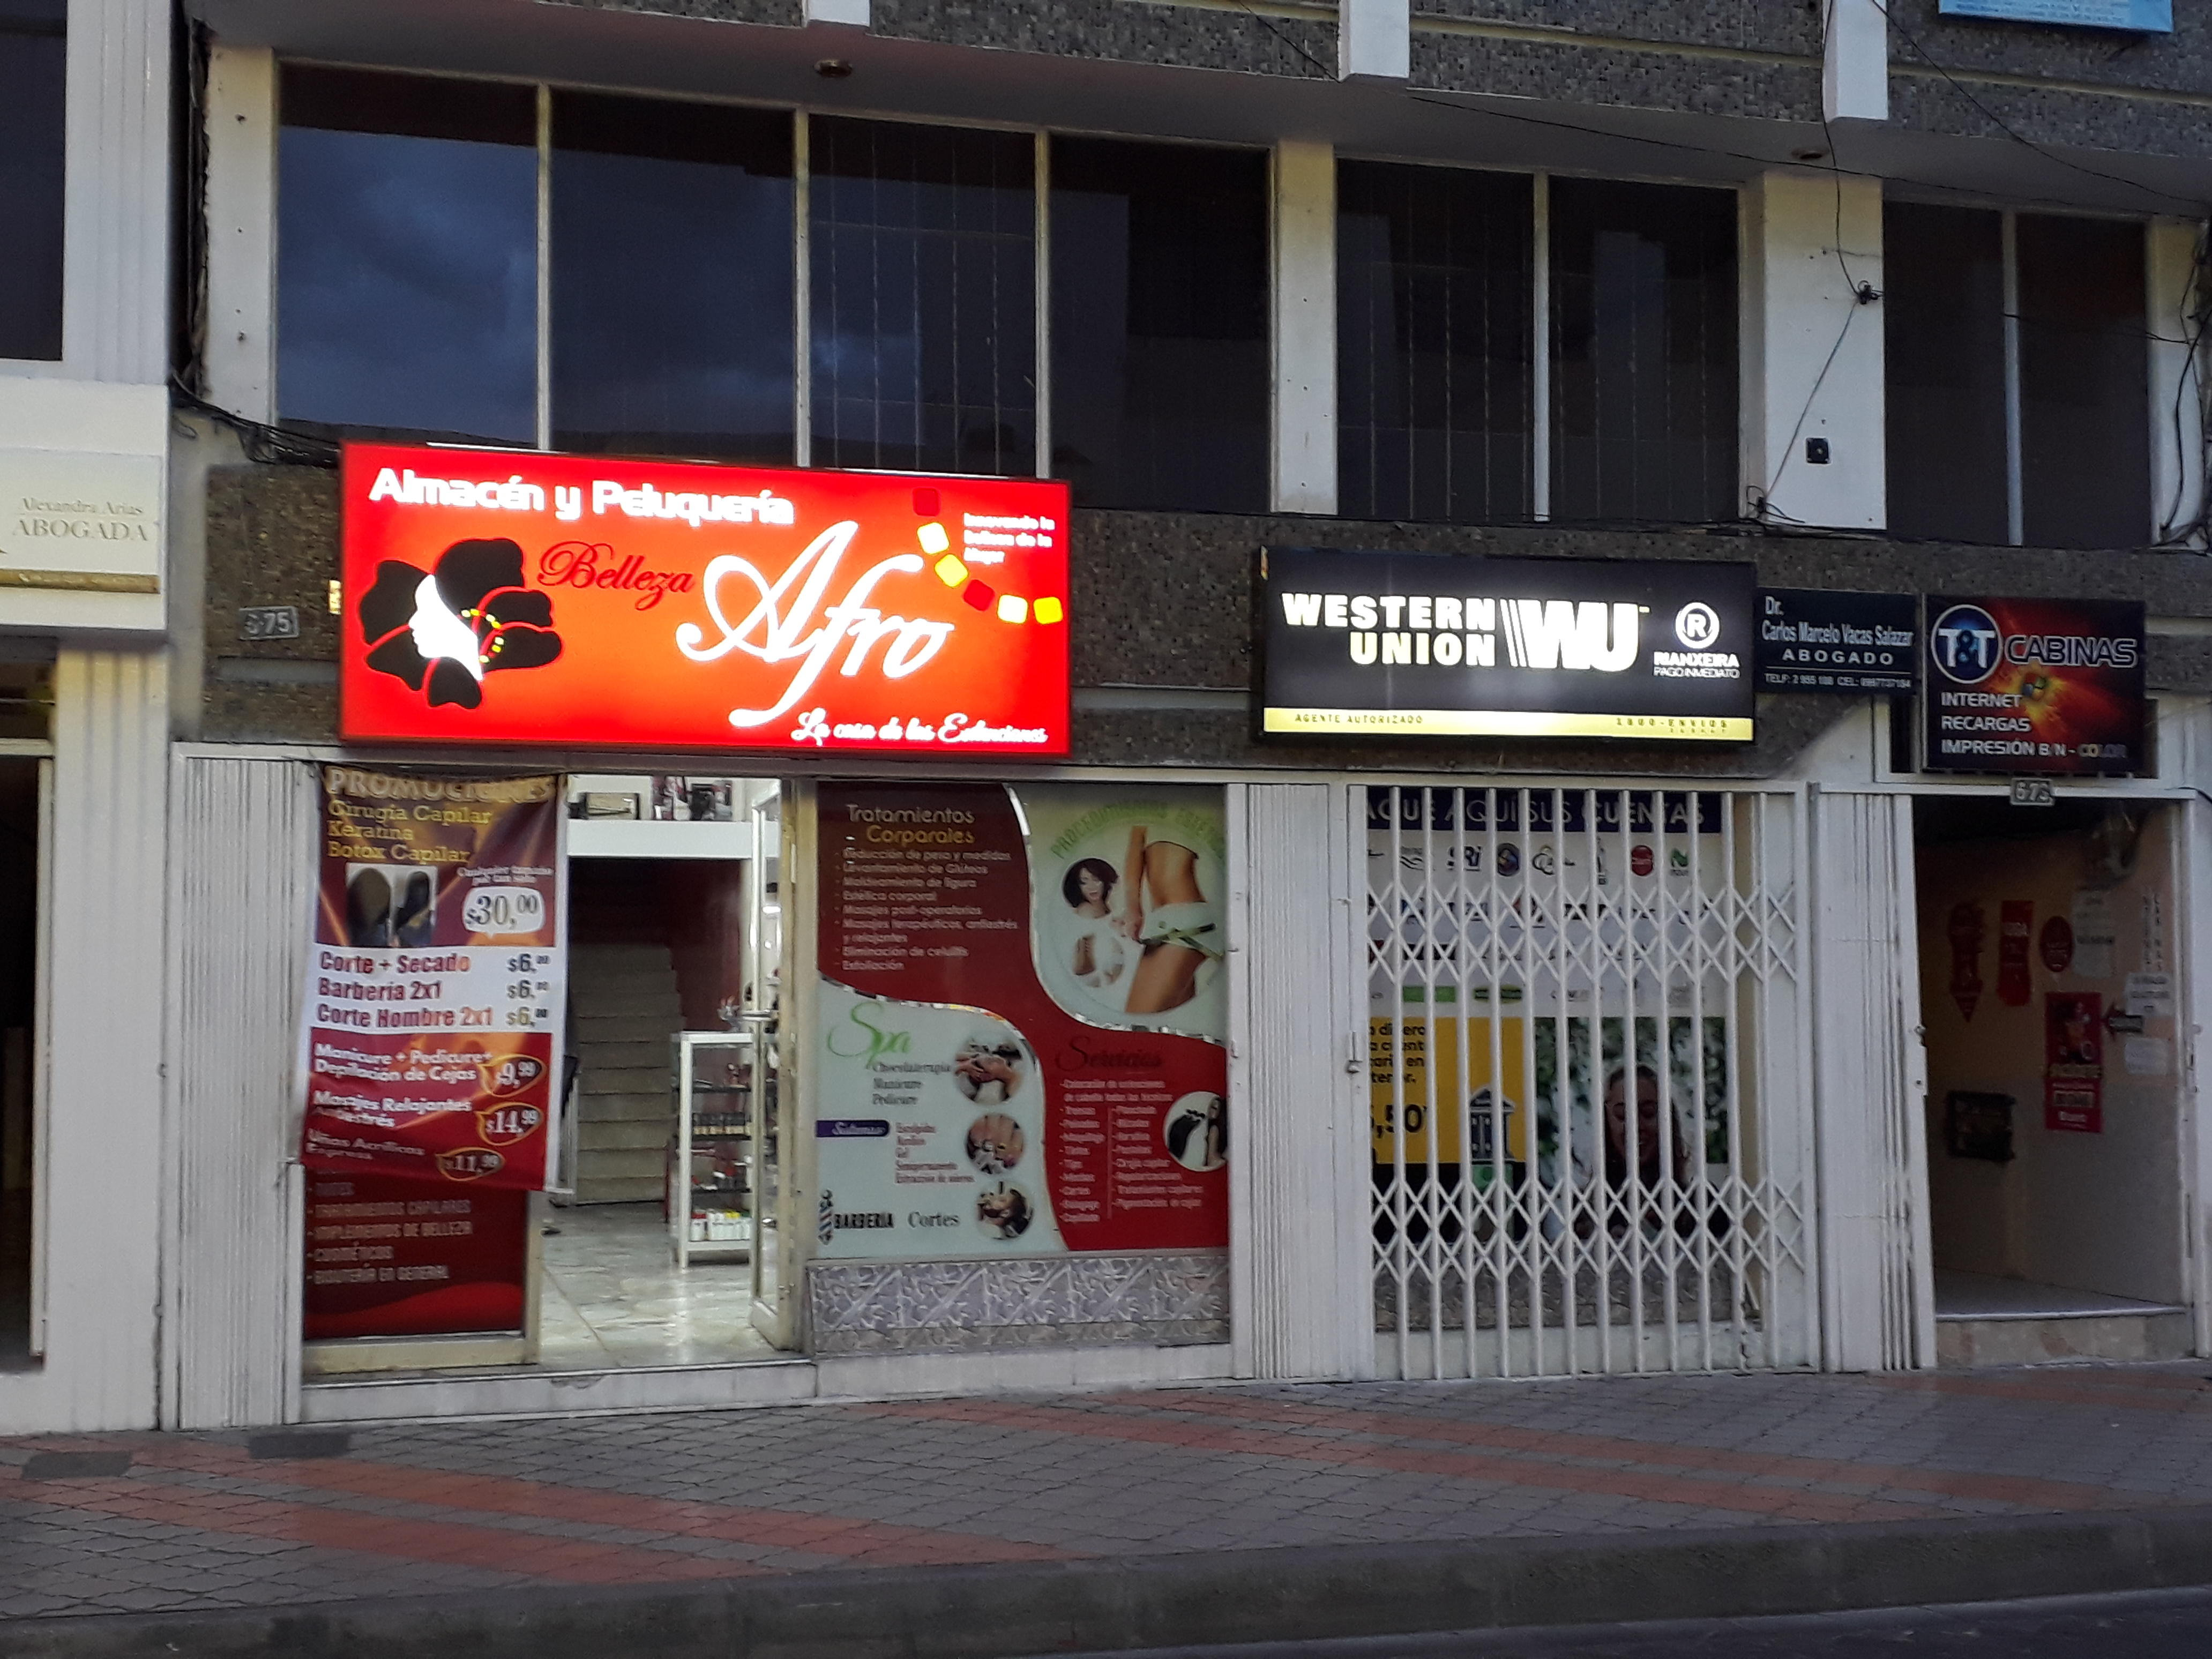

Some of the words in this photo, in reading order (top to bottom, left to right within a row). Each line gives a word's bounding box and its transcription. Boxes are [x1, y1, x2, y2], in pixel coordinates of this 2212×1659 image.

[369, 468, 544, 511] Almacén
[555, 486, 581, 520] y
[592, 480, 794, 527] Peluquería
[13, 519, 148, 541] ABOGADA
[536, 541, 695, 611] Belleza
[1281, 593, 1496, 631] WESTERN
[1765, 596, 1784, 615] Dr.
[675, 519, 955, 728] Afro
[1762, 619, 1797, 641] Carlos
[1798, 621, 1841, 643] Marcelo
[1875, 625, 1914, 646] Salazar
[1349, 632, 1496, 668] UNION
[1782, 648, 1893, 665] ABOGADO
[2005, 634, 2138, 668] CABINAS
[1941, 692, 2022, 707] INTERNET
[790, 707, 831, 746] La
[878, 716, 903, 741] de
[905, 717, 936, 742] las
[1295, 714, 1341, 723] AGENTE
[1347, 715, 1423, 724] AUTORIZADO
[1941, 715, 2031, 732] RECARGAS
[1941, 738, 2035, 756] IMPRESIÓN
[413, 805, 492, 826] Capilar
[845, 804, 975, 824] Tratamientos
[866, 825, 975, 847] Corporales
[328, 841, 384, 858] Botox
[391, 845, 470, 864] Capilar
[320, 951, 373, 974] Corte
[397, 952, 470, 973] Secado
[410, 980, 442, 999] 2x1
[317, 1004, 370, 1026] Corte
[377, 1007, 454, 1027] Hombre
[459, 1007, 493, 1027] 2x1
[827, 1002, 910, 1070] Spa
[315, 1043, 392, 1065] Manicure
[403, 1067, 427, 1081] de
[429, 1066, 476, 1084] Cejas
[382, 1097, 472, 1115] Relajantes
[907, 1211, 960, 1229] Cortes
